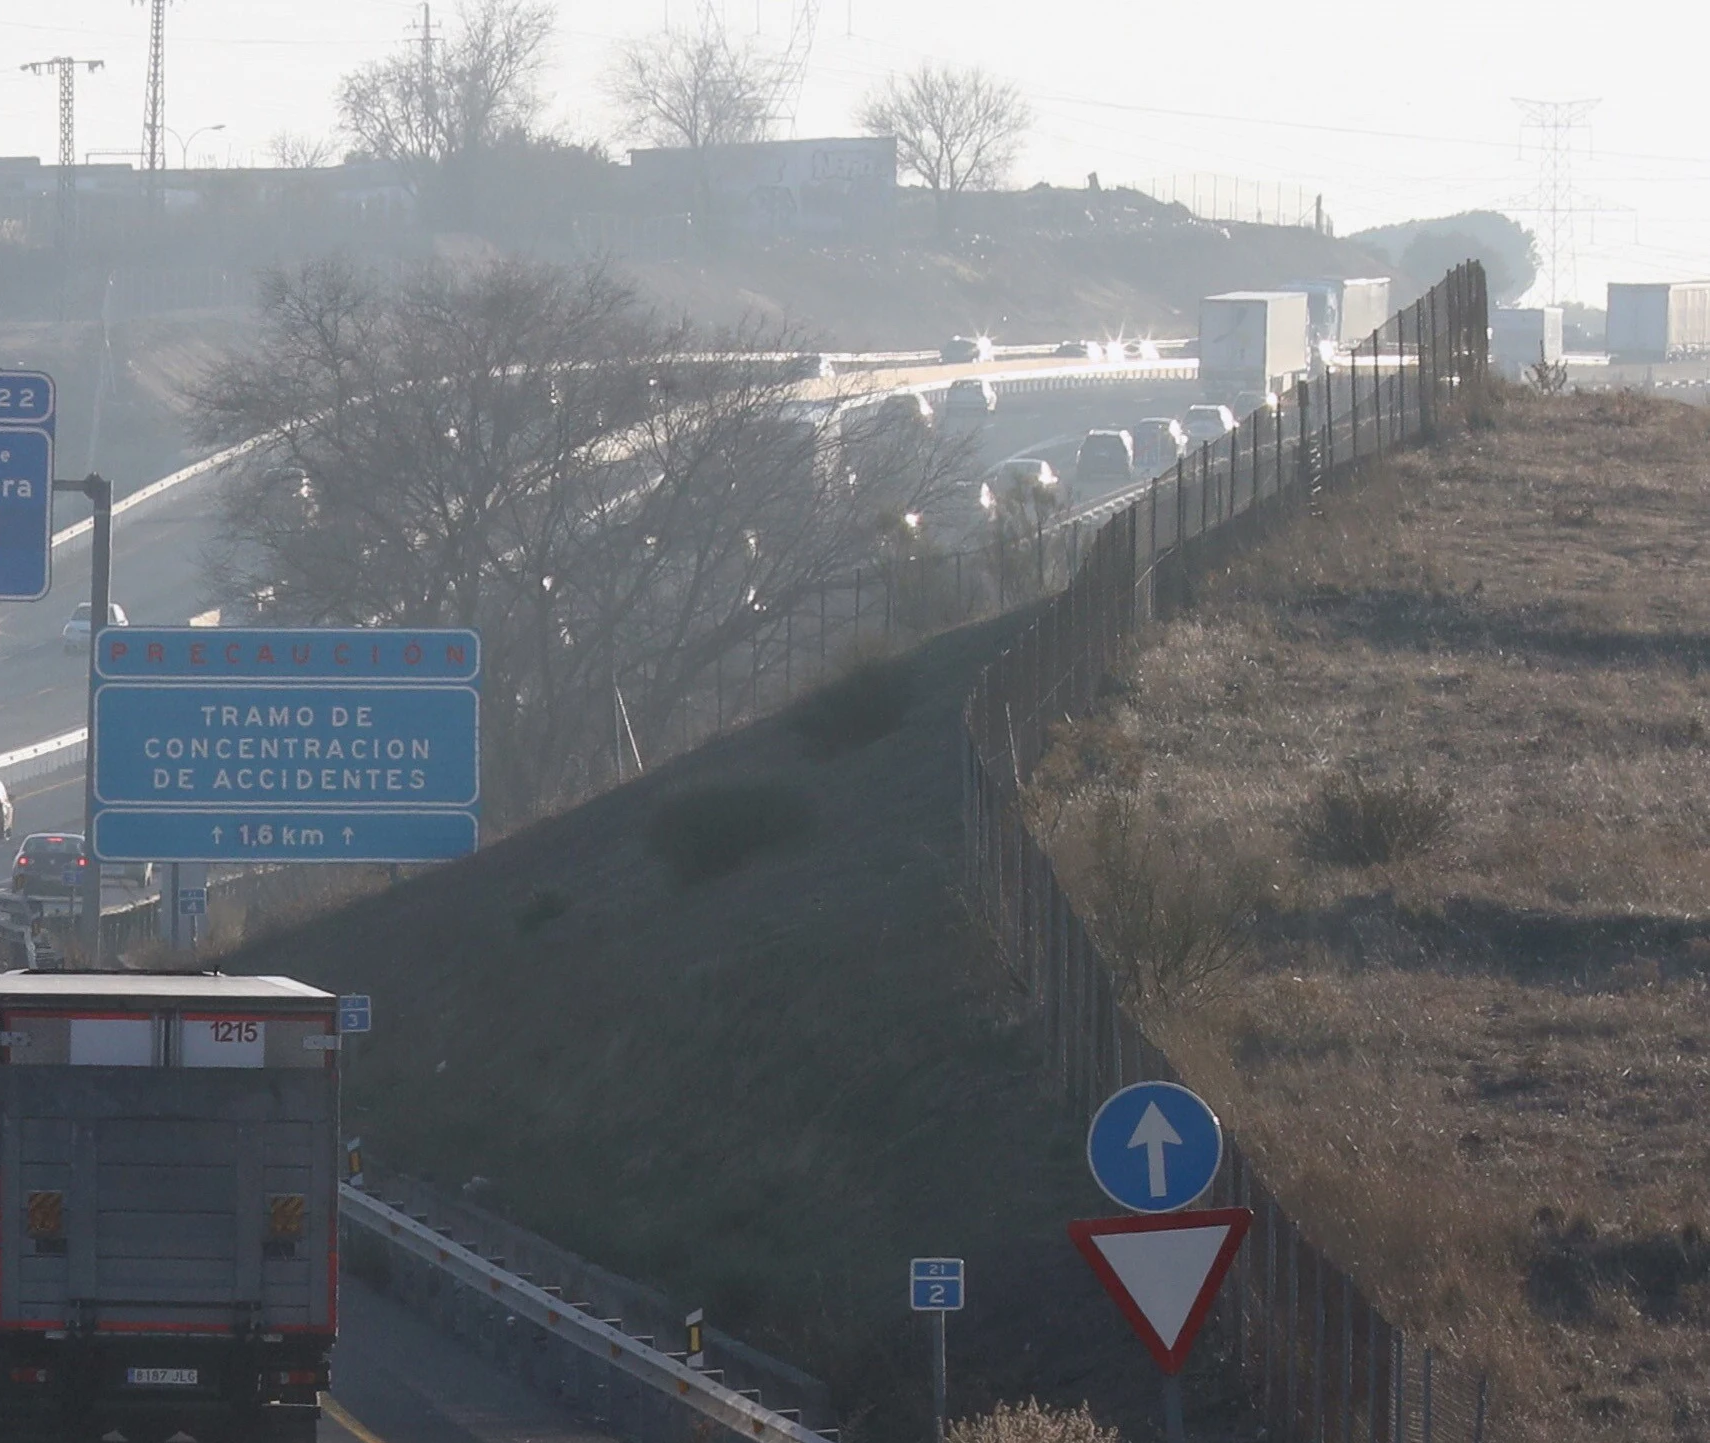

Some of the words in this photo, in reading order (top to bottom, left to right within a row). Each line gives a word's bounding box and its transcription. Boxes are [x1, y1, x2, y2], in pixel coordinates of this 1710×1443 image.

[109, 638, 467, 666] PRECAUCIÓN
[200, 705, 315, 728] TRAMO
[331, 706, 374, 728] DE
[144, 737, 431, 760] CONCENTRACION
[153, 768, 195, 790] DE
[212, 768, 428, 791] ACCIDENTES
[239, 824, 274, 848] 1,6
[282, 824, 325, 846] km
[209, 1021, 258, 1043] 1215
[347, 1015, 359, 1027] 3
[929, 1264, 945, 1275] 21
[929, 1284, 945, 1305] 2
